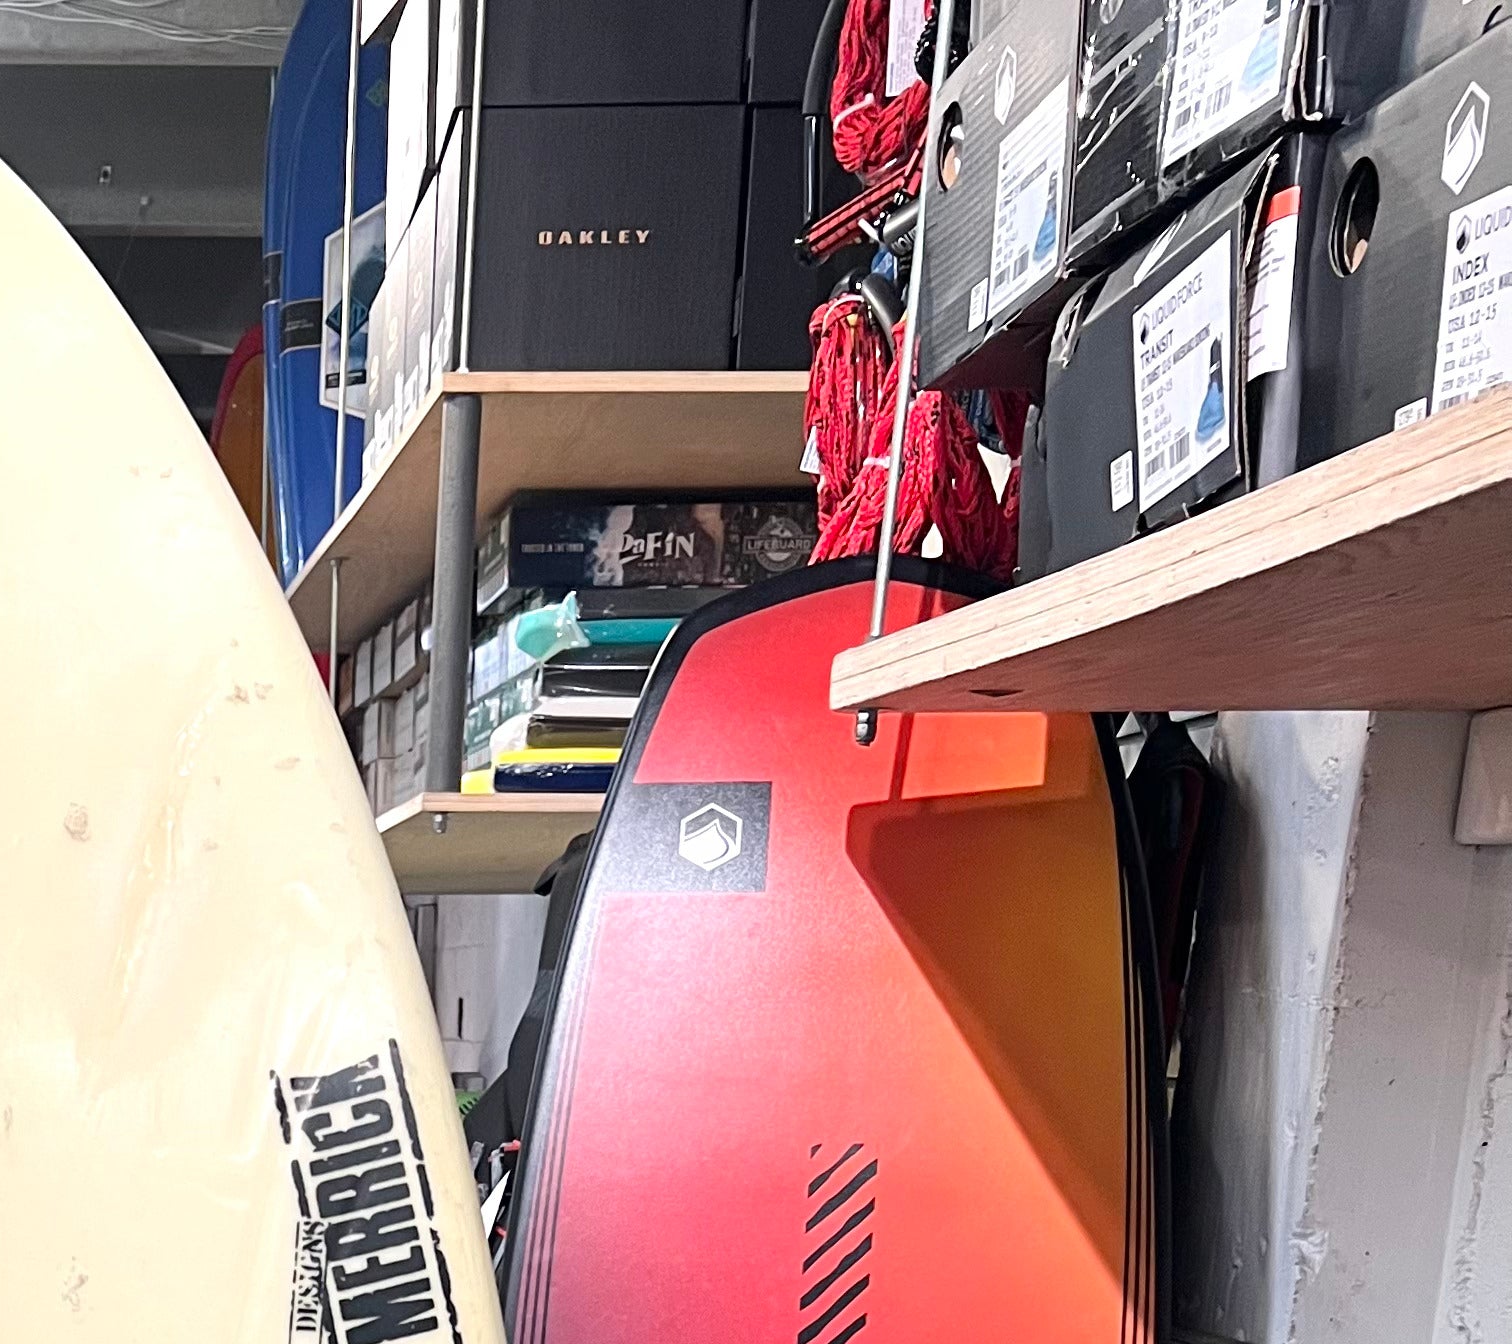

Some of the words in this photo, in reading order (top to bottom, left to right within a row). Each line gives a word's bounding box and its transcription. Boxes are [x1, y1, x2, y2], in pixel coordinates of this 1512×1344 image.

[538, 229, 650, 245] OAKLEY
[1451, 252, 1490, 286] INDEX
[1140, 328, 1174, 370] TRANSIT
[296, 1220, 326, 1332] DESIGNS
